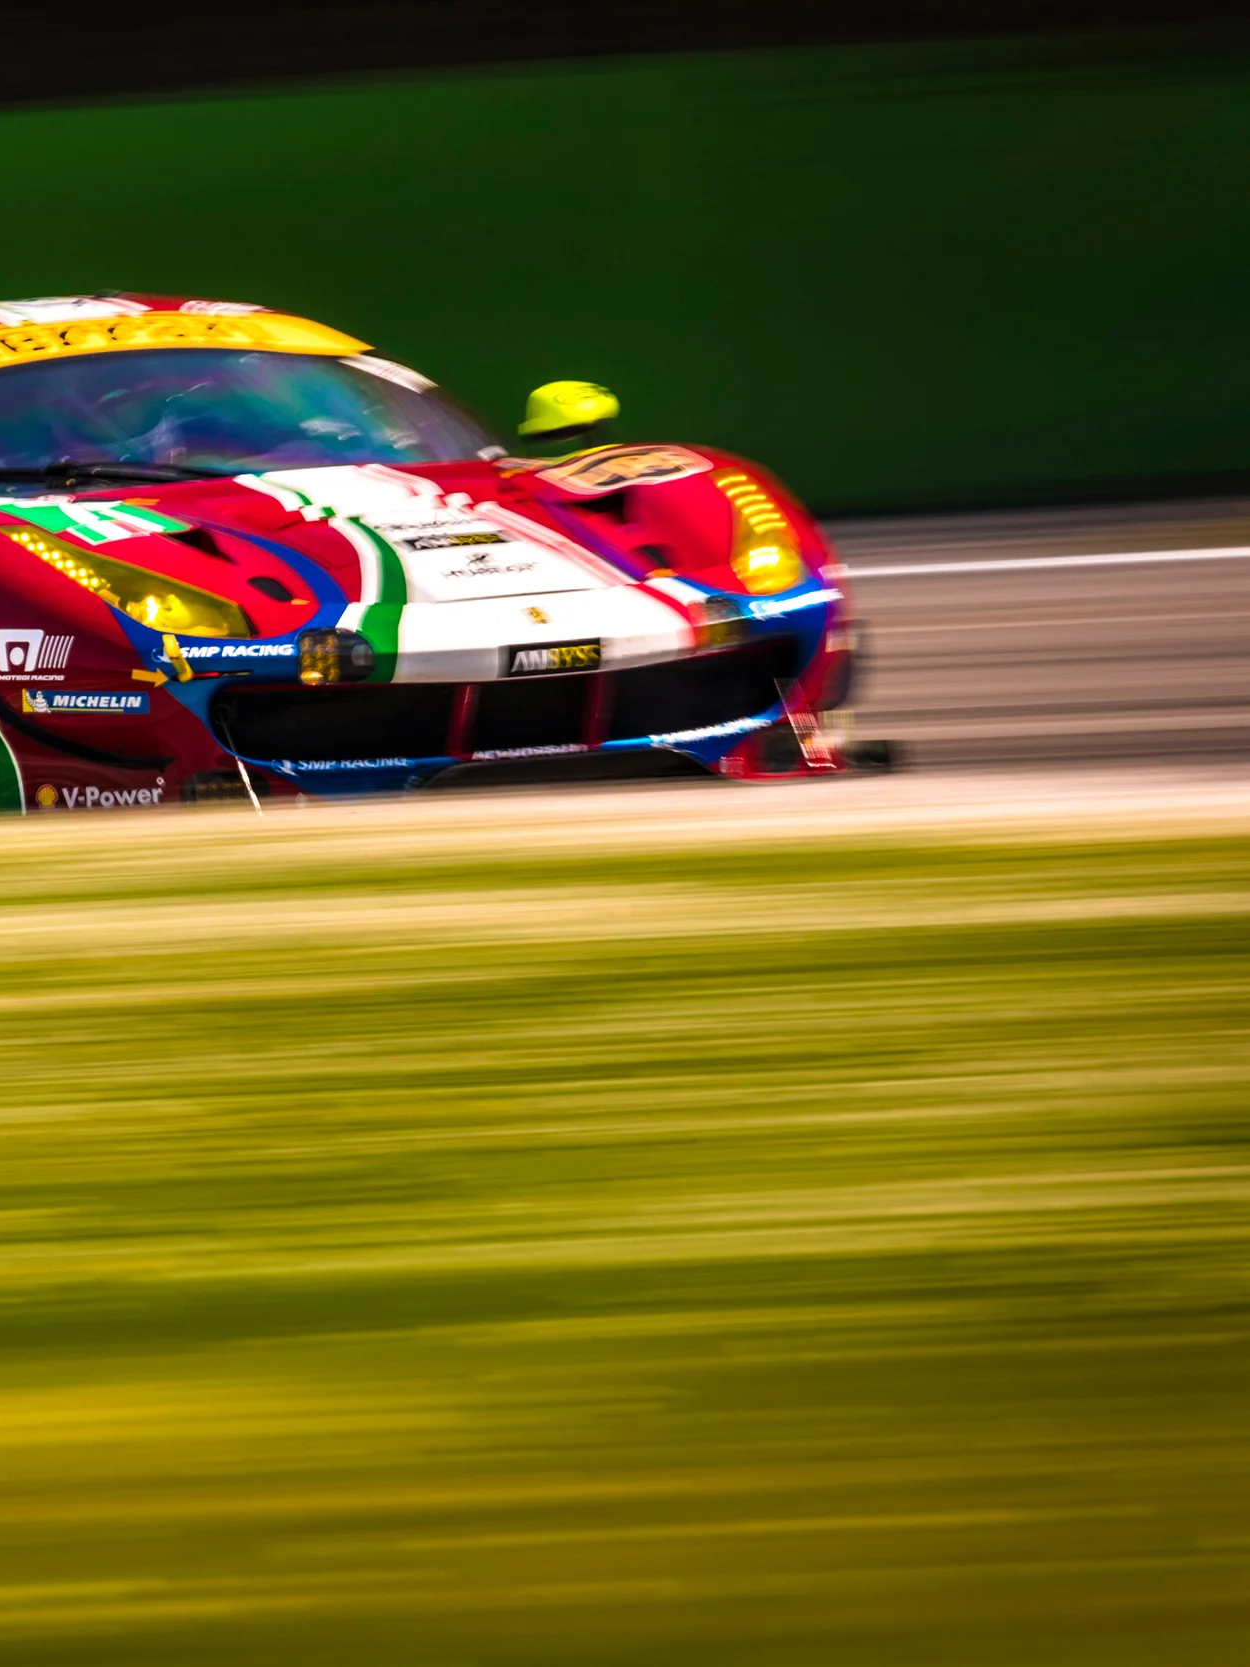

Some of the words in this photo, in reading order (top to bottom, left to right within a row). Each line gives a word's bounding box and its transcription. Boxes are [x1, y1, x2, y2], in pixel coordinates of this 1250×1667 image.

[180, 646, 220, 658] SMP
[222, 644, 295, 657] RACING
[52, 695, 142, 708] MICHELIN
[62, 785, 163, 810] V-Power
